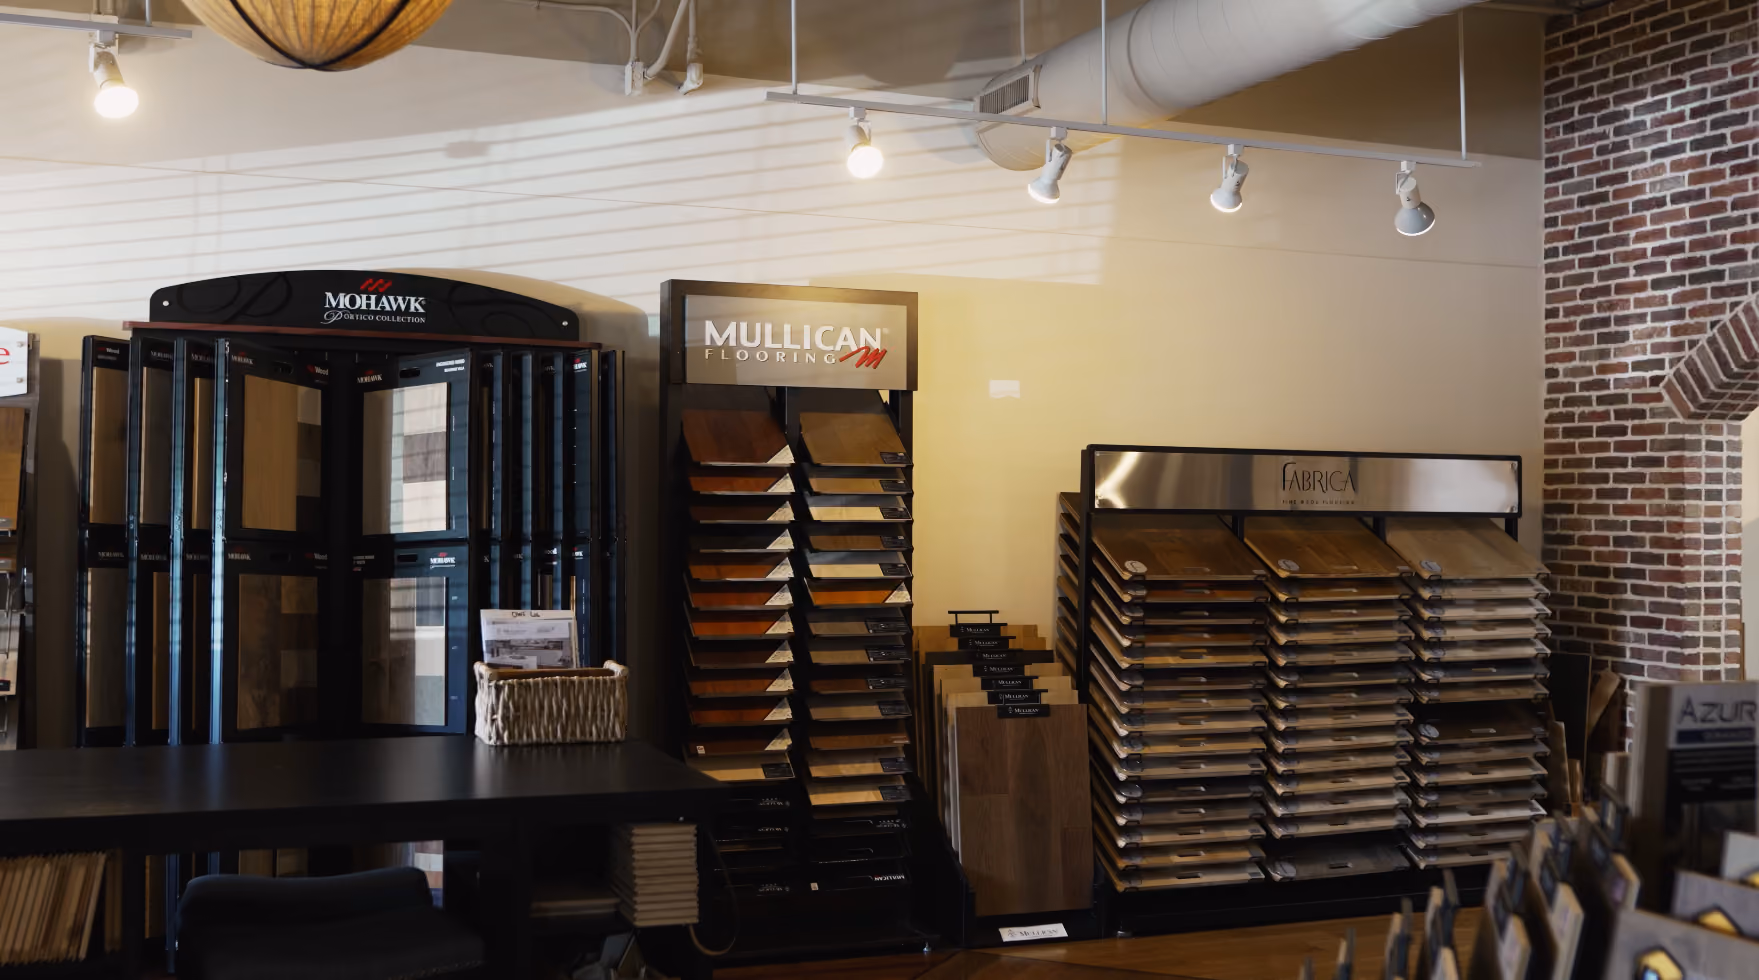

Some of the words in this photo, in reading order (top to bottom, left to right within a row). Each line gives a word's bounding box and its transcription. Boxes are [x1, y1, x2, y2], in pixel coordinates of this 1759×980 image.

[324, 291, 426, 313] MOHAWK
[375, 313, 426, 323] COLLECTION
[704, 320, 884, 351] MULLICAN
[704, 348, 837, 364] FLOORING
[1282, 462, 1356, 493] FABRICA
